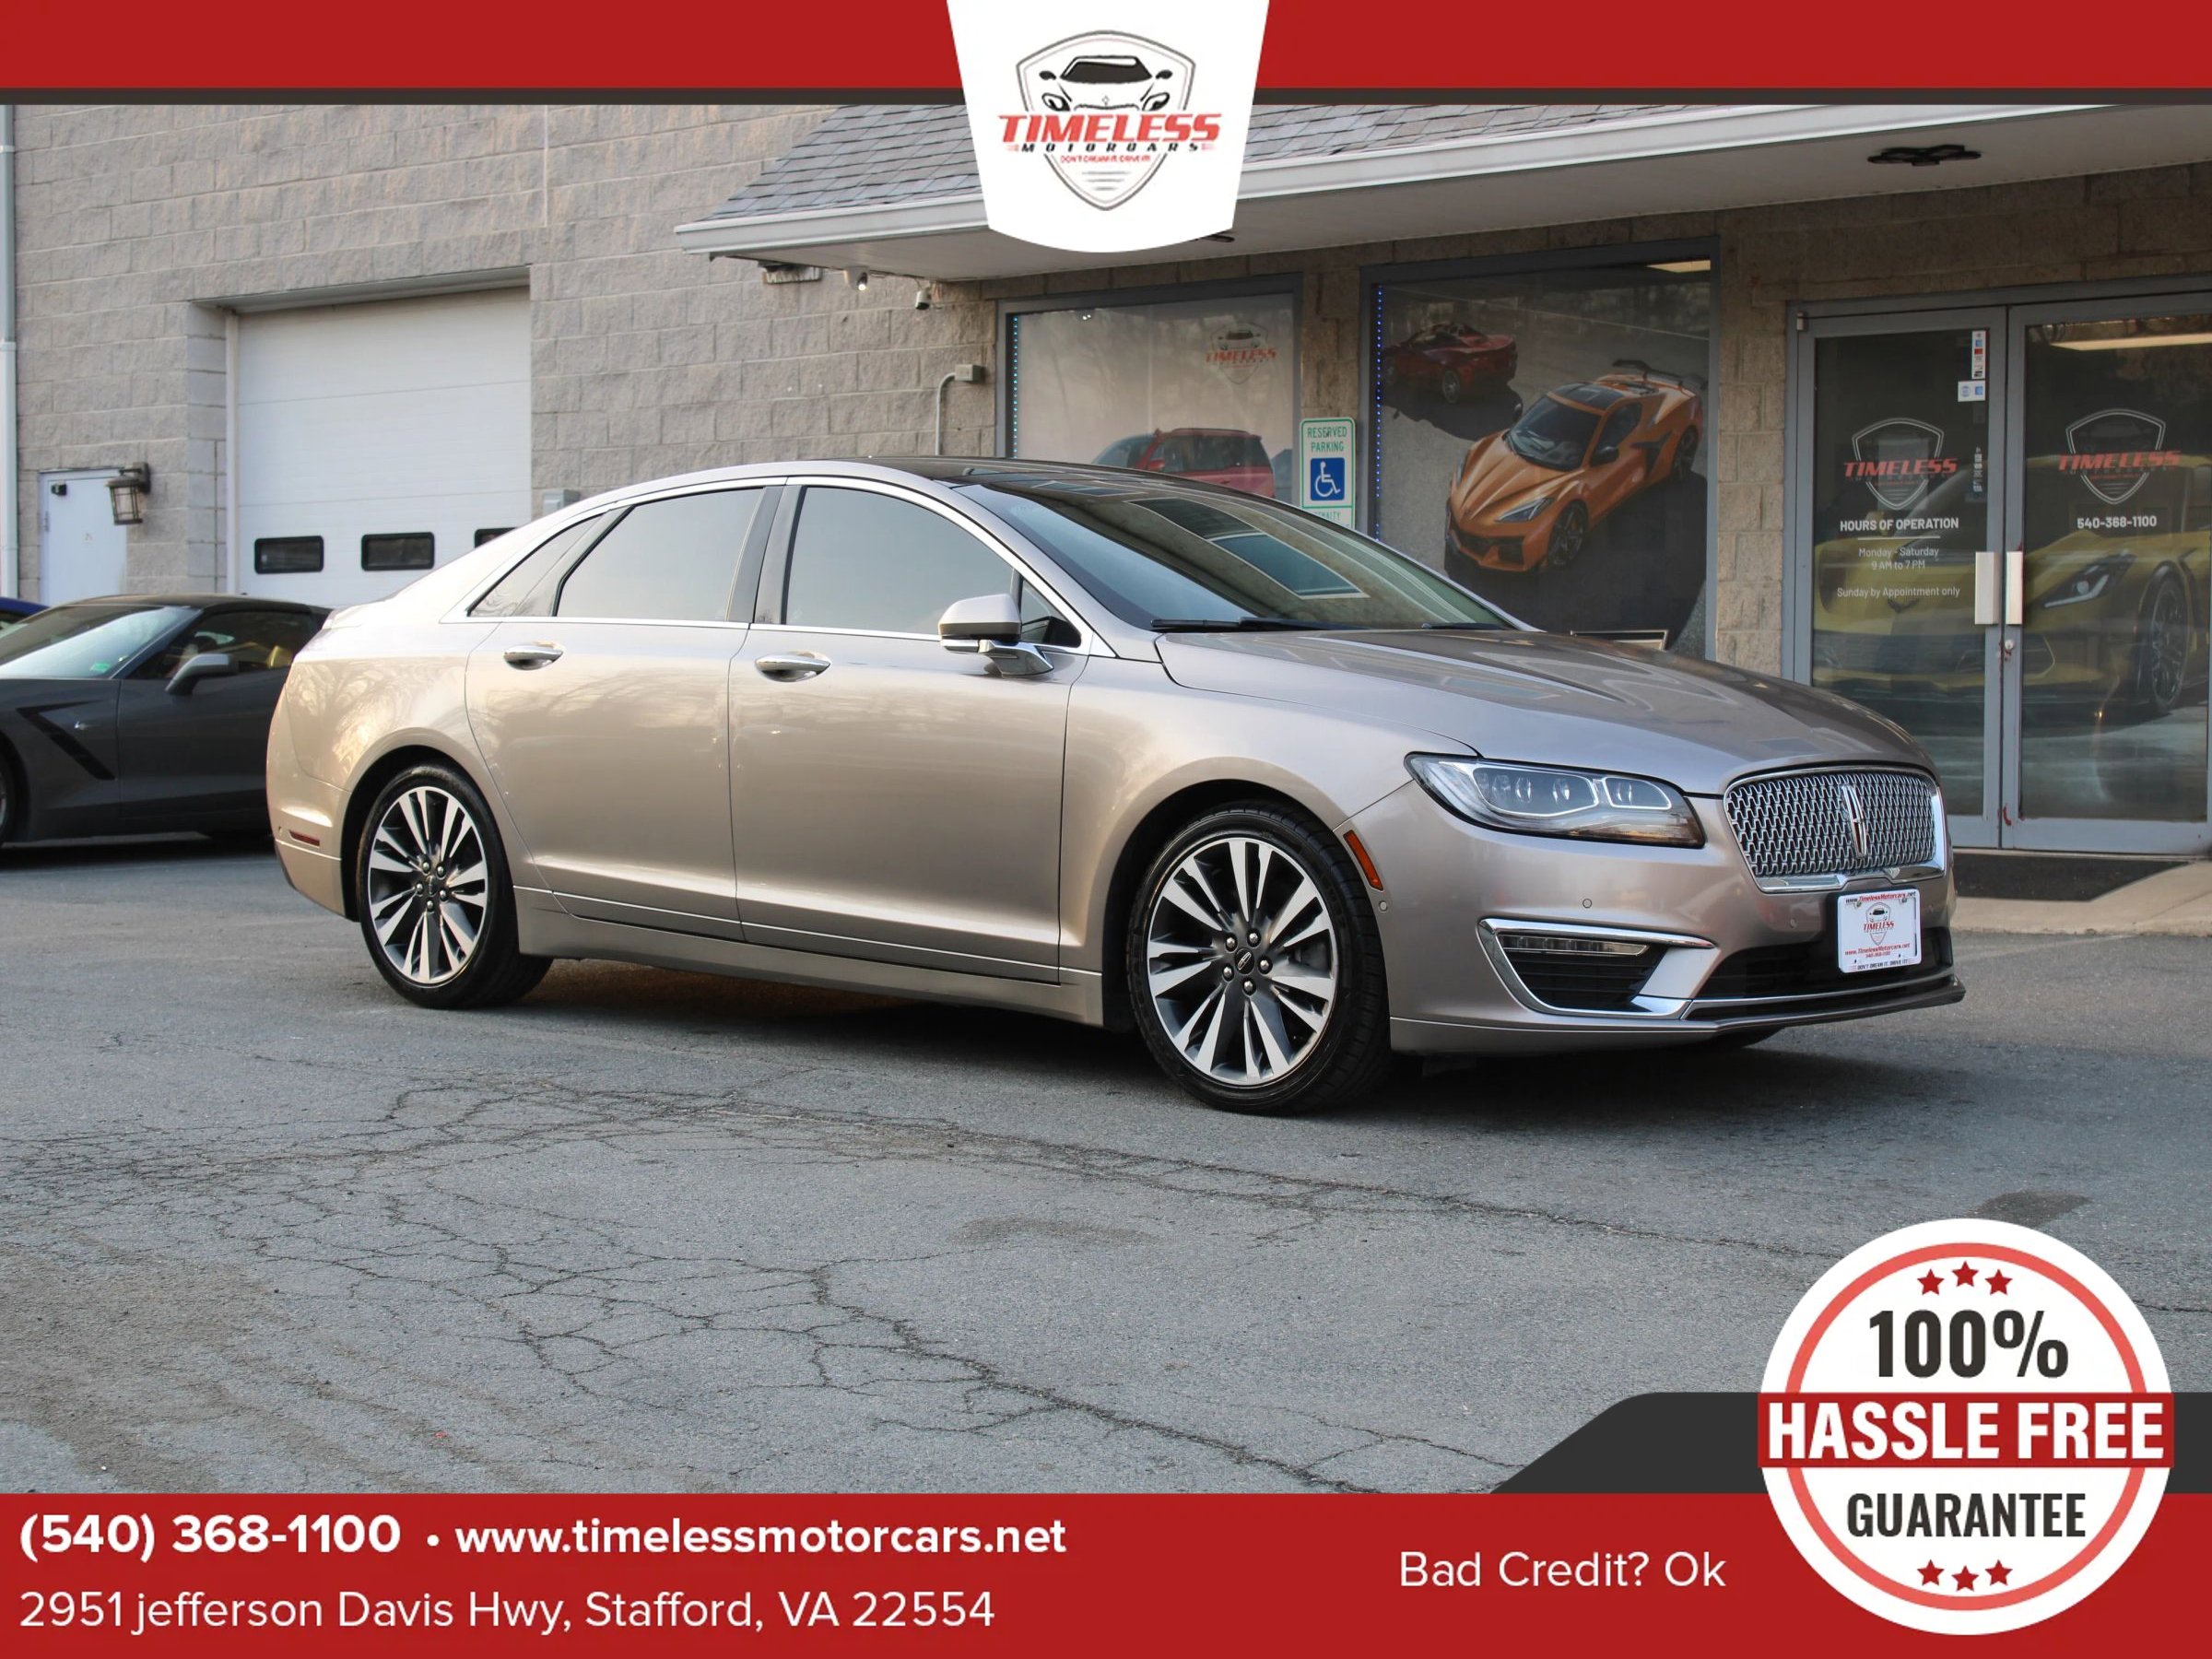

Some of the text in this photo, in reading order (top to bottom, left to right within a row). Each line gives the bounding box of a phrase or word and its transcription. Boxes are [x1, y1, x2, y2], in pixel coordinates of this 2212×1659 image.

[1307, 426, 1347, 439] RESERVED
[1311, 441, 1345, 453] PARKING
[1844, 458, 1959, 477] TIMELESS
[2058, 451, 2182, 471] TIMELESS
[1840, 517, 1959, 532] HOURS OF OPERATION
[2077, 515, 2158, 529] 540-368-1100
[1858, 547, 1892, 559] Monday
[1900, 546, 1939, 559] Saturday
[1871, 559, 1925, 571] 9 AM to 7 PM
[1837, 585, 1961, 599] Sunday by Appointment only
[1864, 922, 1894, 931] TIMELESS
